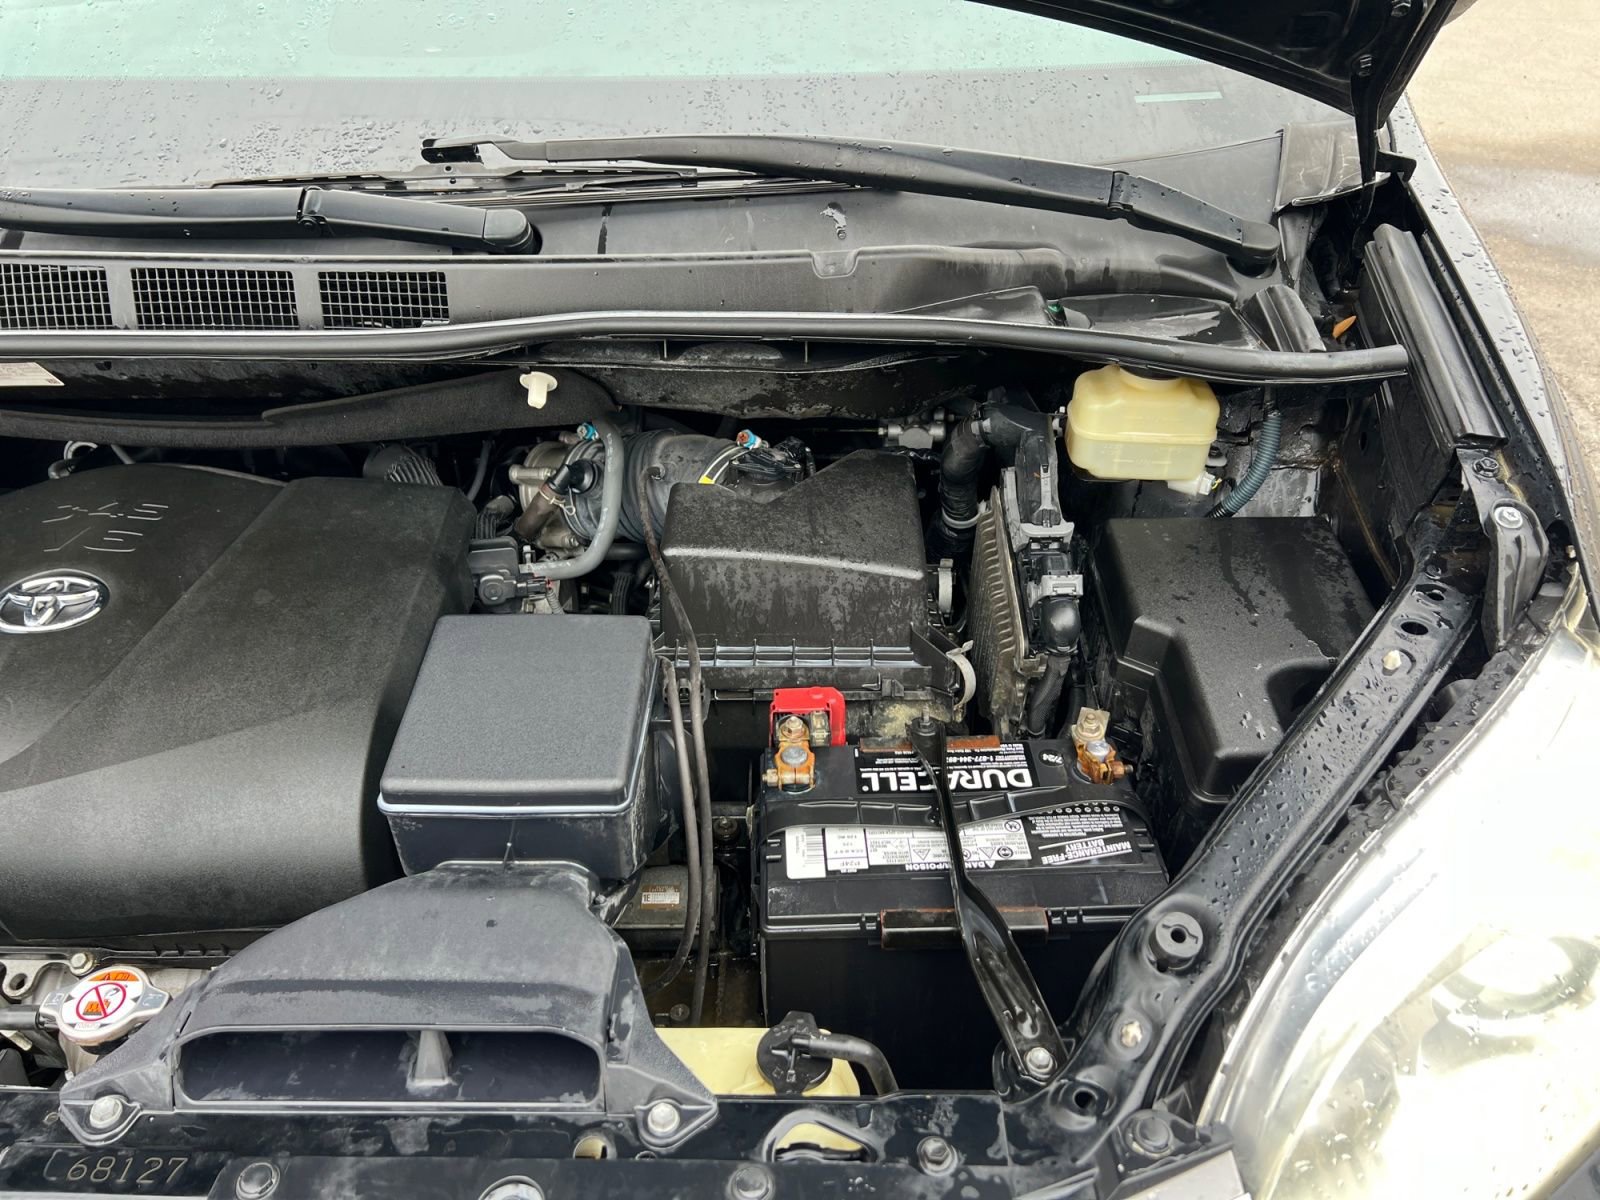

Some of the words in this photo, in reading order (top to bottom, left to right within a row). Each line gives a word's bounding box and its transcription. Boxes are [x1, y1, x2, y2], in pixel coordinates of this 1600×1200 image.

[1042, 753, 1063, 764] 7/24
[1065, 838, 1105, 852] BATTERY
[1041, 840, 1132, 865] MAINTENANCE-FREE
[905, 861, 985, 871] DANR/POISON
